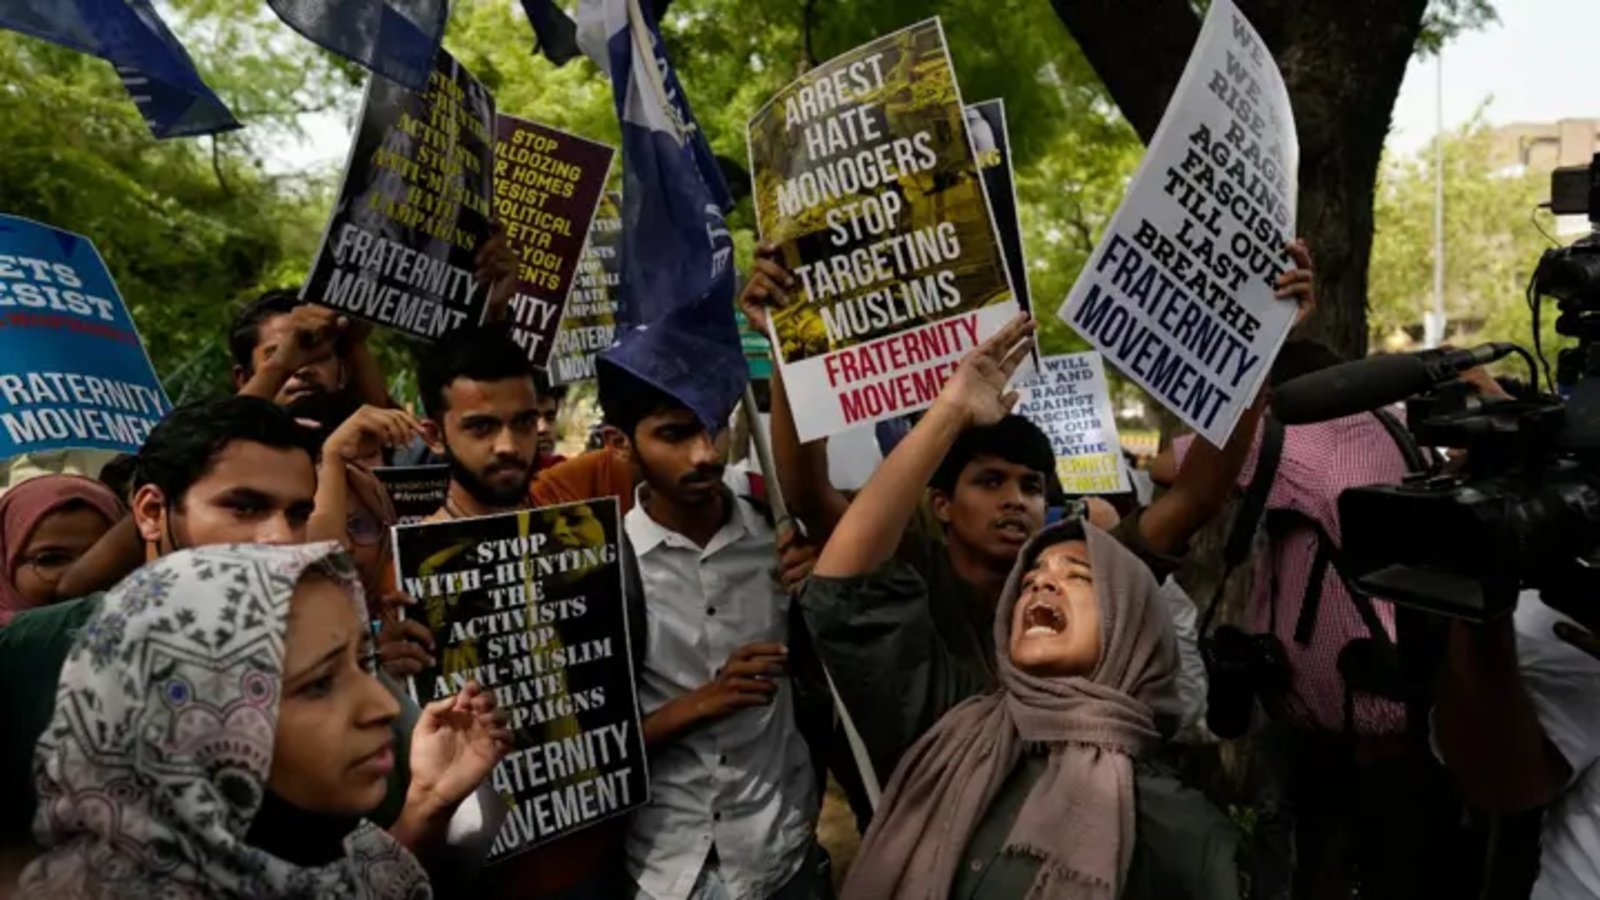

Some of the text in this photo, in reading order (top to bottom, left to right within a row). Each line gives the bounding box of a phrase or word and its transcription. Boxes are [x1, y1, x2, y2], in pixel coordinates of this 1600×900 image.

[785, 53, 886, 132] ARREST
[1207, 68, 1266, 139] RISE
[512, 129, 558, 152] STOP
[804, 103, 881, 161] HATE
[512, 165, 575, 198] HOMES
[775, 130, 937, 217] MONOGERS
[1164, 167, 1222, 237] TILL
[499, 217, 552, 249] ETTA
[826, 190, 901, 247] STOP
[334, 224, 480, 306] FRATERNITY
[794, 222, 961, 303] TARGETING
[1133, 219, 1261, 343] BREATHE
[1175, 219, 1248, 291] LAST
[322, 268, 468, 338] MOVEMENT
[819, 270, 961, 342] MUSLIMS
[1096, 233, 1259, 387] FRATERNITY
[823, 313, 980, 388] FRATERNITY
[1044, 357, 1090, 372] WILL
[1056, 368, 1094, 383] AND
[1073, 284, 1231, 429] MOVEMENT
[839, 360, 959, 424] MOVEME
[1031, 384, 1077, 399] RAGE
[405, 543, 617, 599] WITH-HUNTING
[477, 532, 547, 564] STOP
[448, 596, 588, 643] ACTIVISTS
[488, 580, 545, 610] THE
[488, 627, 555, 659] STOP
[494, 672, 562, 707] HATE
[505, 687, 606, 730] PAIGNS
